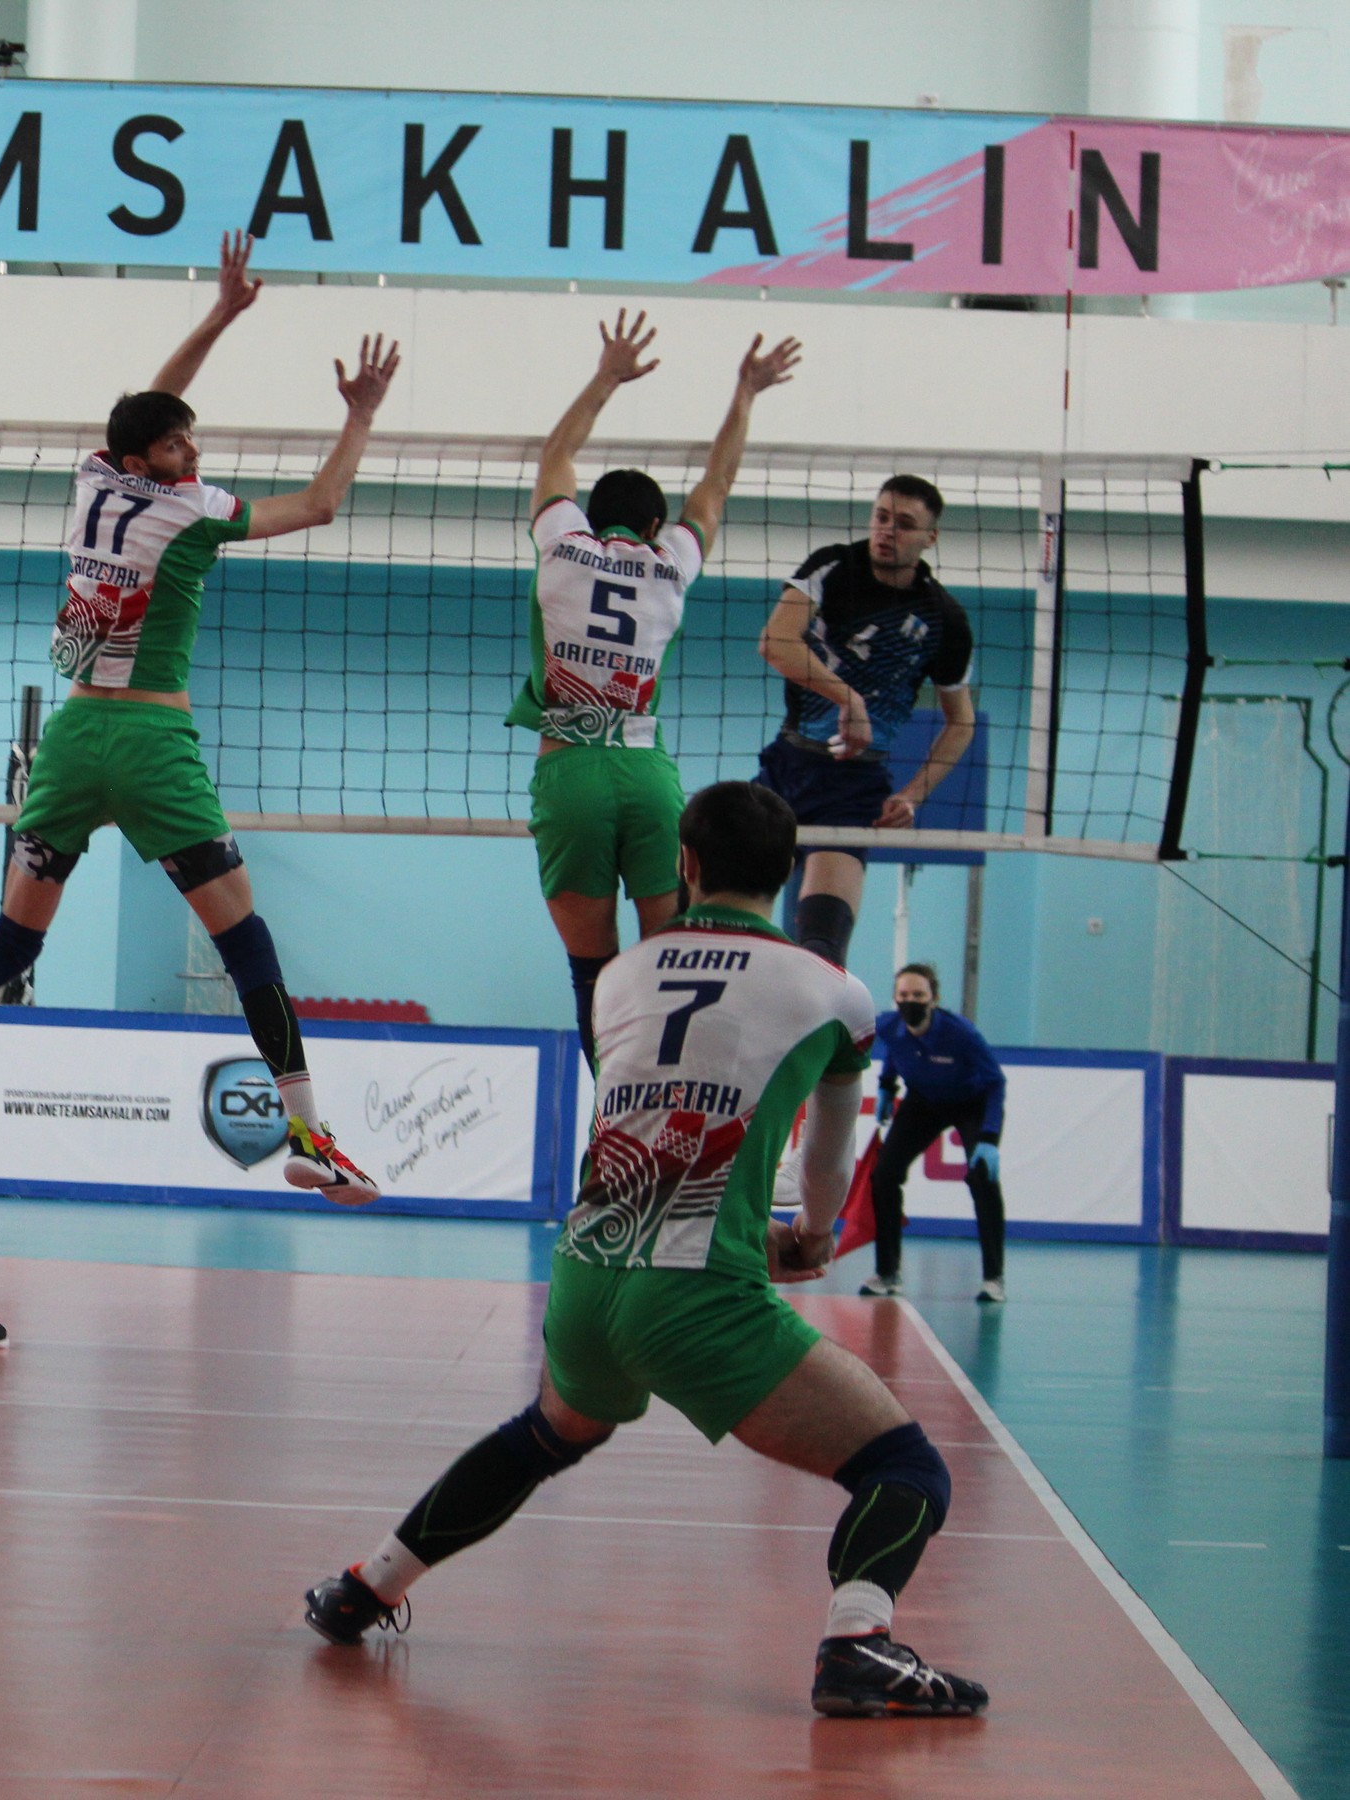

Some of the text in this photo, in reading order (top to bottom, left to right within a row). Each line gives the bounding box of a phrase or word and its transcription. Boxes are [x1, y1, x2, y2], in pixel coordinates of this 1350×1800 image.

[83, 488, 153, 555] 17
[587, 579, 637, 646] 5
[553, 641, 655, 675] ДАГЕСТАН
[656, 948, 751, 971] АДАМ
[657, 981, 727, 1066] 7
[3, 1100, 170, 1121] WWW.ONETEAMSAKHALIN.COM
[603, 1080, 742, 1117] ДАГЕСТАН
